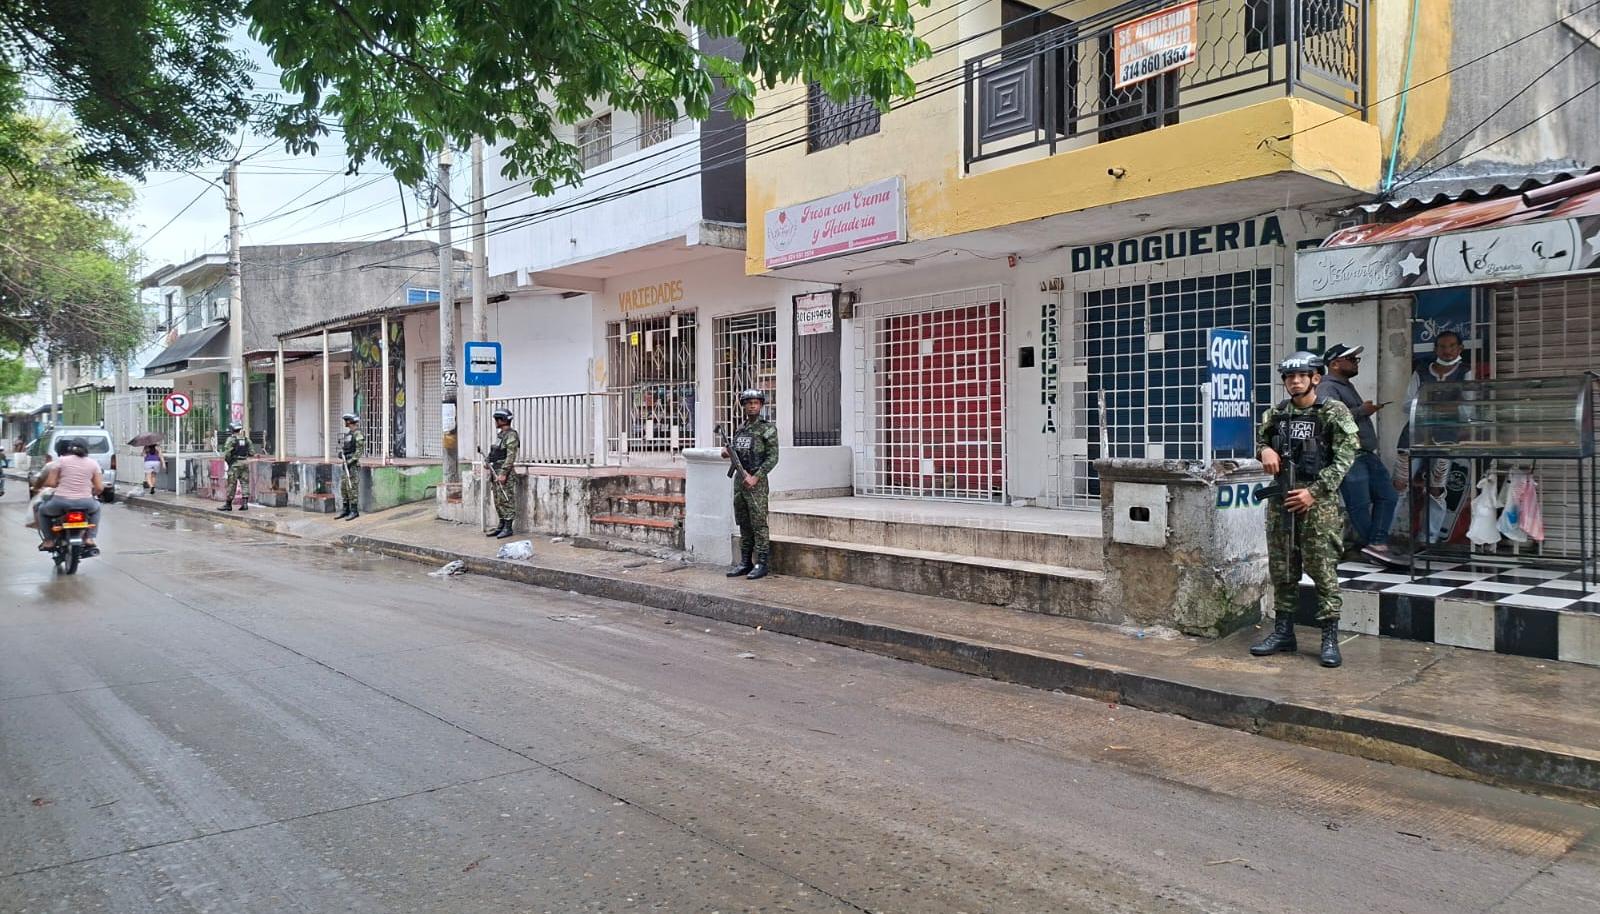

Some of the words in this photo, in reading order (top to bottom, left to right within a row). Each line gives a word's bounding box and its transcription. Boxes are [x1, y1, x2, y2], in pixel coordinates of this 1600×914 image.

[1122, 61, 1139, 82] 314
[1141, 53, 1160, 75] 860
[1161, 45, 1188, 67] 1353
[833, 199, 851, 214] con
[852, 190, 891, 209] Crema
[811, 229, 821, 245] y
[1071, 215, 1285, 273] DROGUERIA
[618, 279, 684, 313] VARIEDADES
[445, 373, 456, 383] 24
[1211, 372, 1246, 401] MEGA
[1212, 401, 1251, 418] FARMACIA
